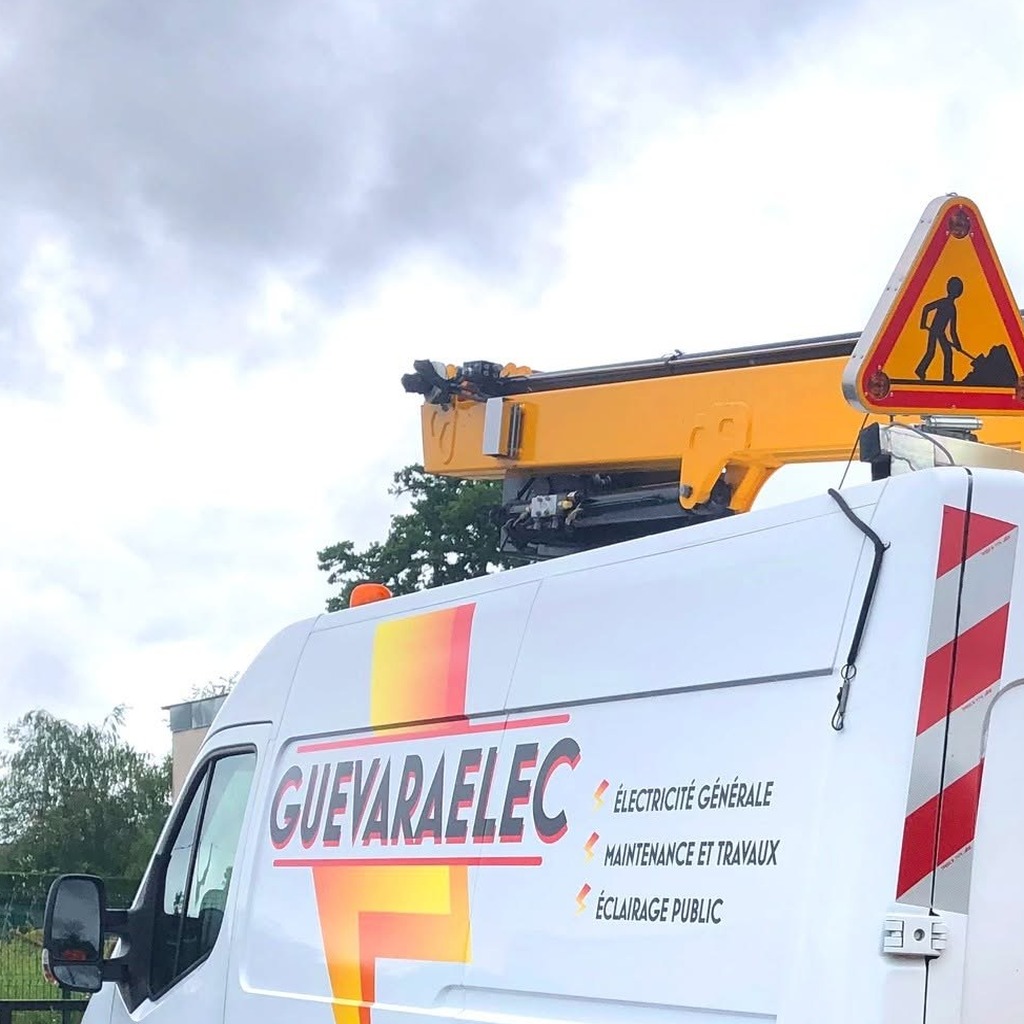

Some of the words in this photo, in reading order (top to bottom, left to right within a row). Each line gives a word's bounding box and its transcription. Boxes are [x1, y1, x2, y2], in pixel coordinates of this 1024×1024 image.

[269, 737, 581, 850] GUEVARAELEC
[613, 779, 696, 813] ÉLECTRICITÉ
[697, 776, 774, 810] GÉNÉRALE
[604, 841, 696, 866] MAINTENANCE
[697, 841, 714, 866] ET
[716, 840, 780, 866] TRAVAUX
[595, 890, 670, 922] ÉCLAIRAGE
[671, 898, 724, 924] PUBLIC
